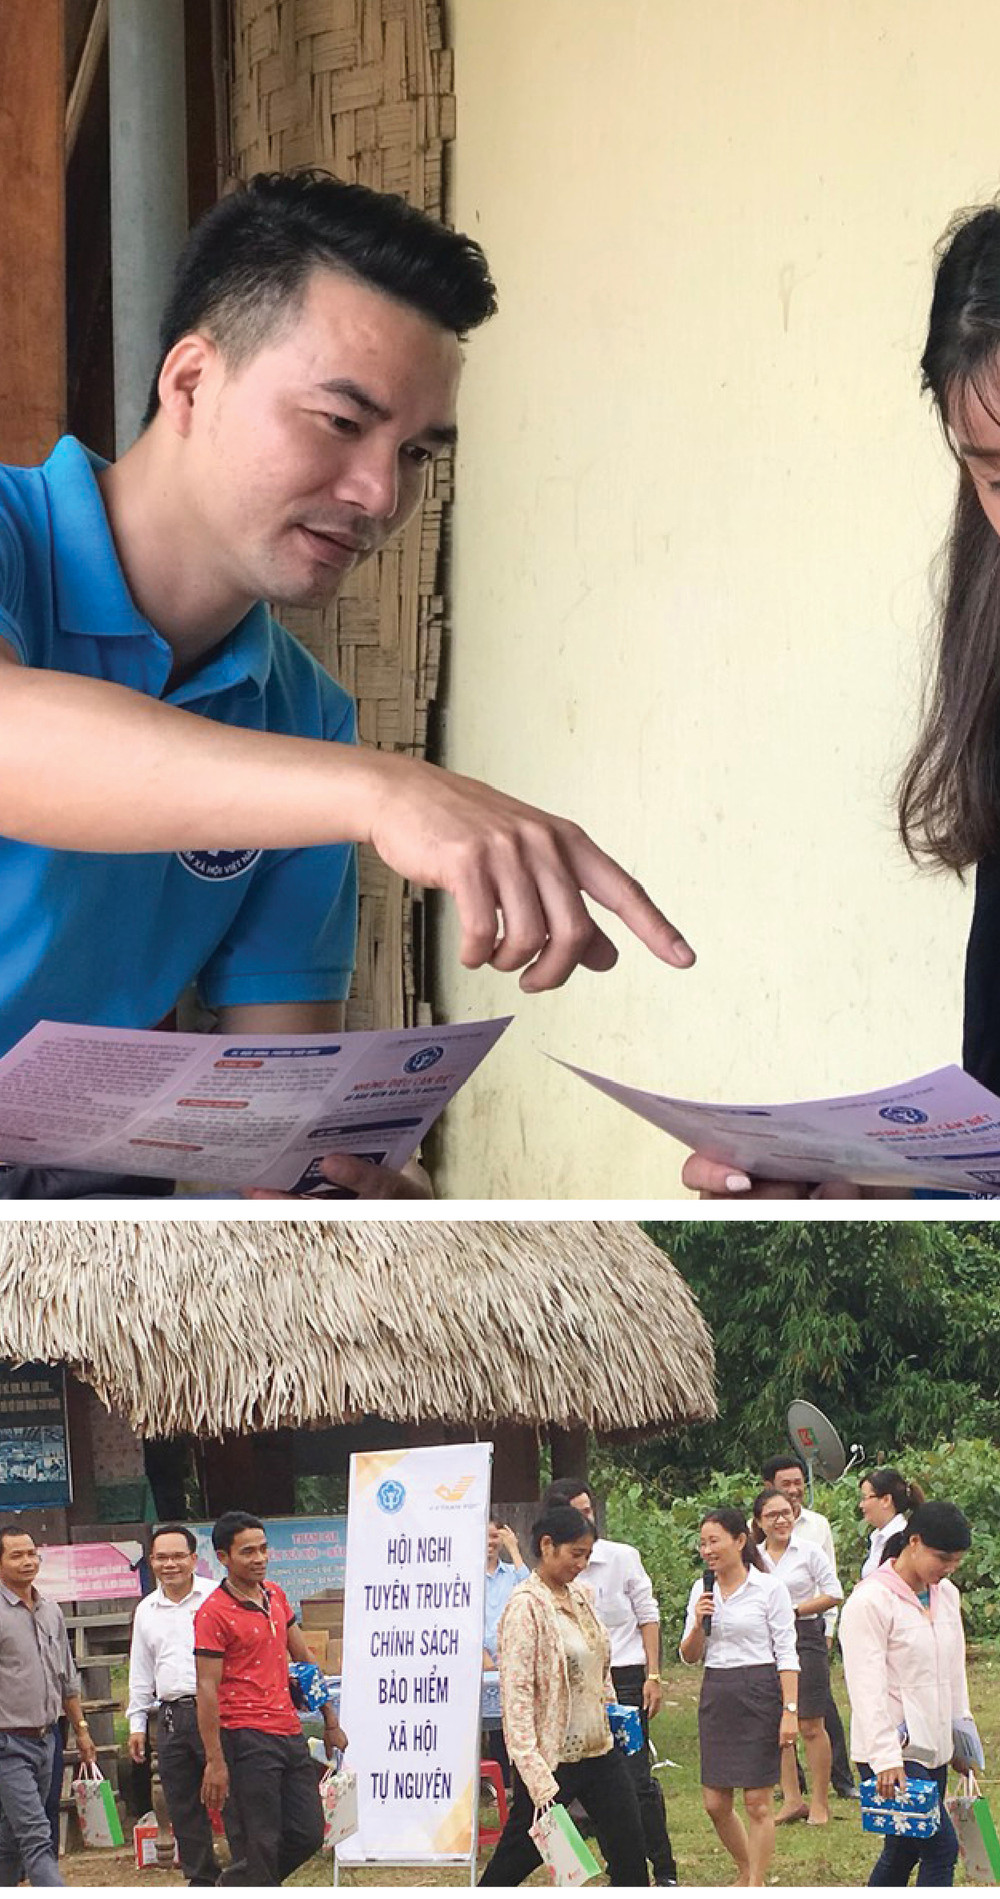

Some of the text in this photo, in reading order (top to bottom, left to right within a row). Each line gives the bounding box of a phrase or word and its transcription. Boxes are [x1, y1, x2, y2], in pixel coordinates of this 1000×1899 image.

[387, 1533, 452, 1570] HỘI NGHỊ
[364, 1573, 471, 1611] TUYÊN TRUYỀN
[370, 1624, 459, 1657] CHÍNH SÁCH
[378, 1664, 448, 1704] BẢO HIỂM
[388, 1719, 437, 1756] XÃ HỘI
[370, 1767, 452, 1805] TỰ NGUYỆN
